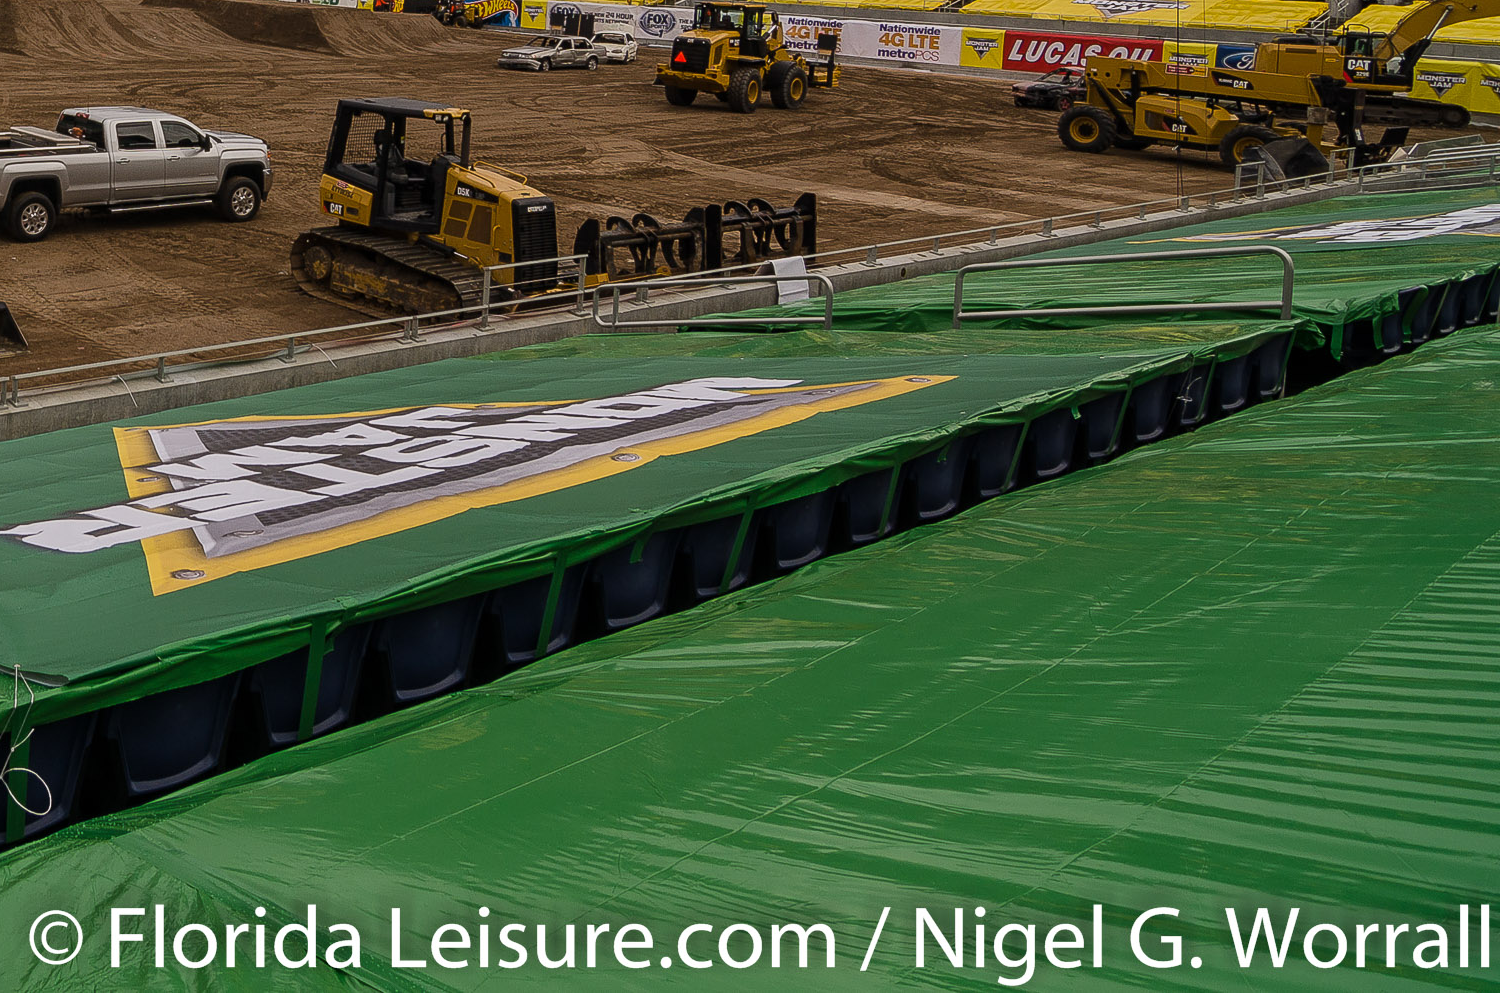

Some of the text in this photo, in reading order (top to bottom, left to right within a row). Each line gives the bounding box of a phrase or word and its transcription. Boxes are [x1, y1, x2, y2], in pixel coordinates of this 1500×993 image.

[647, 13, 669, 25] FOX
[787, 17, 842, 29] Nationwide
[785, 25, 811, 40] 4G
[879, 23, 941, 36] Nationwide
[878, 33, 940, 50] 4G LTE
[965, 40, 999, 48] MONSTER
[878, 48, 940, 62] metroPCS
[1008, 39, 1102, 67] LUCAS
[1347, 59, 1371, 71] CAT
[1233, 79, 1249, 89] CAT
[1416, 74, 1467, 84] MONSTER
[1172, 123, 1188, 133] CAT
[330, 202, 343, 215] CAT
[146, 406, 484, 482] JAM
